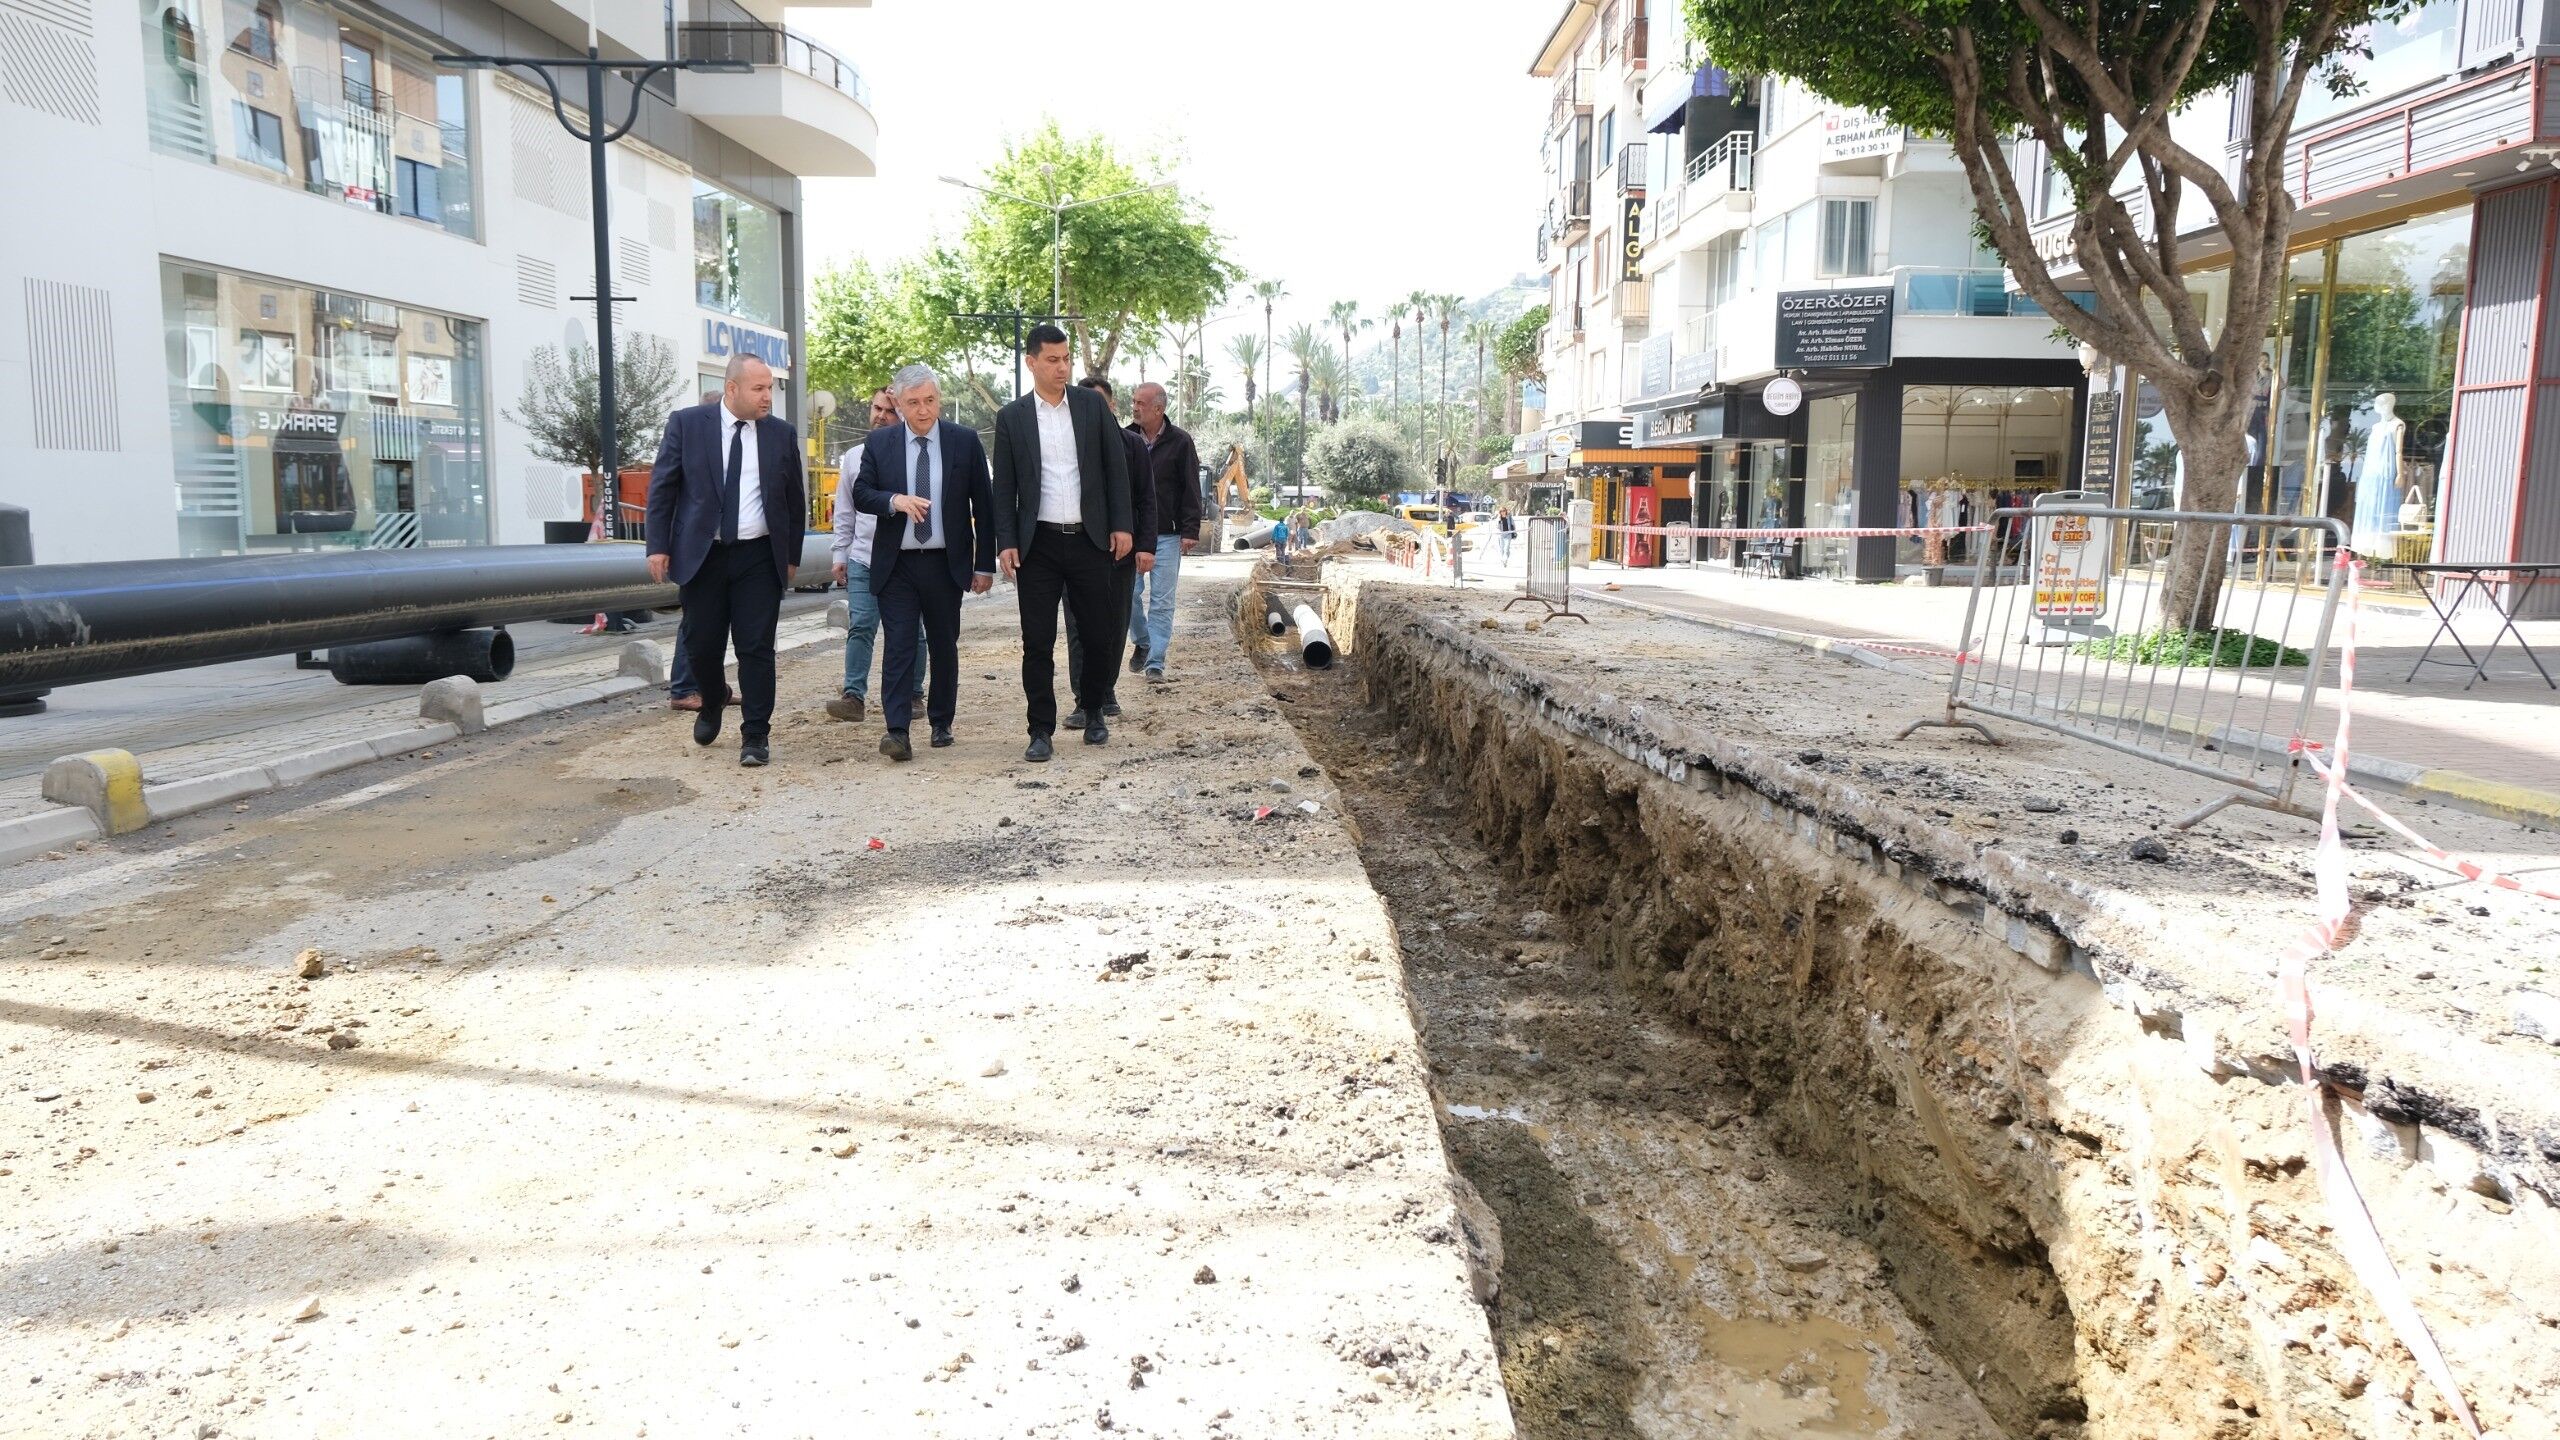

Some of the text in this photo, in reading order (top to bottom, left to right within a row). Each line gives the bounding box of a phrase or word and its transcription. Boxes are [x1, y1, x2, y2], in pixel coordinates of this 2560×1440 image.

[1782, 294, 1886, 310] ÖZER&ÖZER
[706, 318, 729, 357] LC
[604, 472, 614, 536] UYGUN CEN
